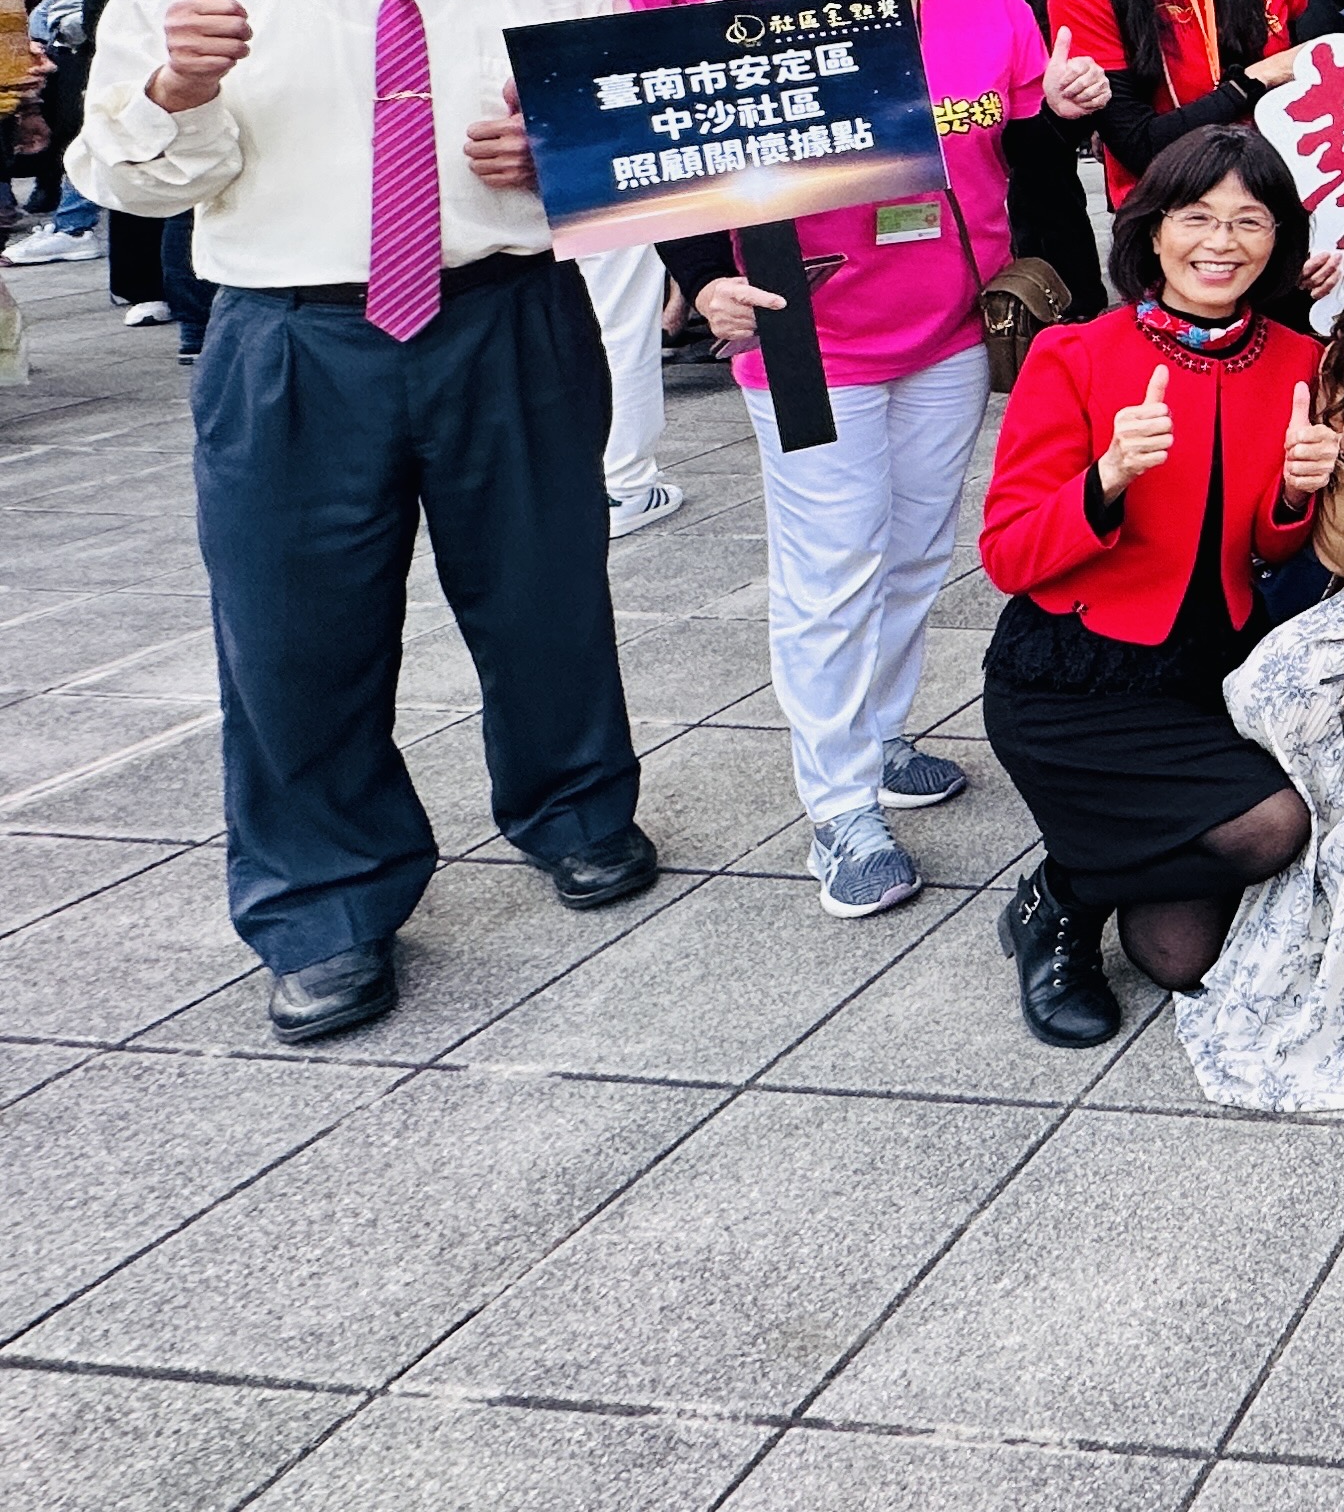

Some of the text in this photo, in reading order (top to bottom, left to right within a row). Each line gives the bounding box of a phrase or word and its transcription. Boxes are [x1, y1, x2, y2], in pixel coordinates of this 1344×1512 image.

[594, 41, 860, 111] 臺南市安定區
[651, 86, 825, 141] 中沙社區
[612, 117, 874, 191] 照顧關懷據點
